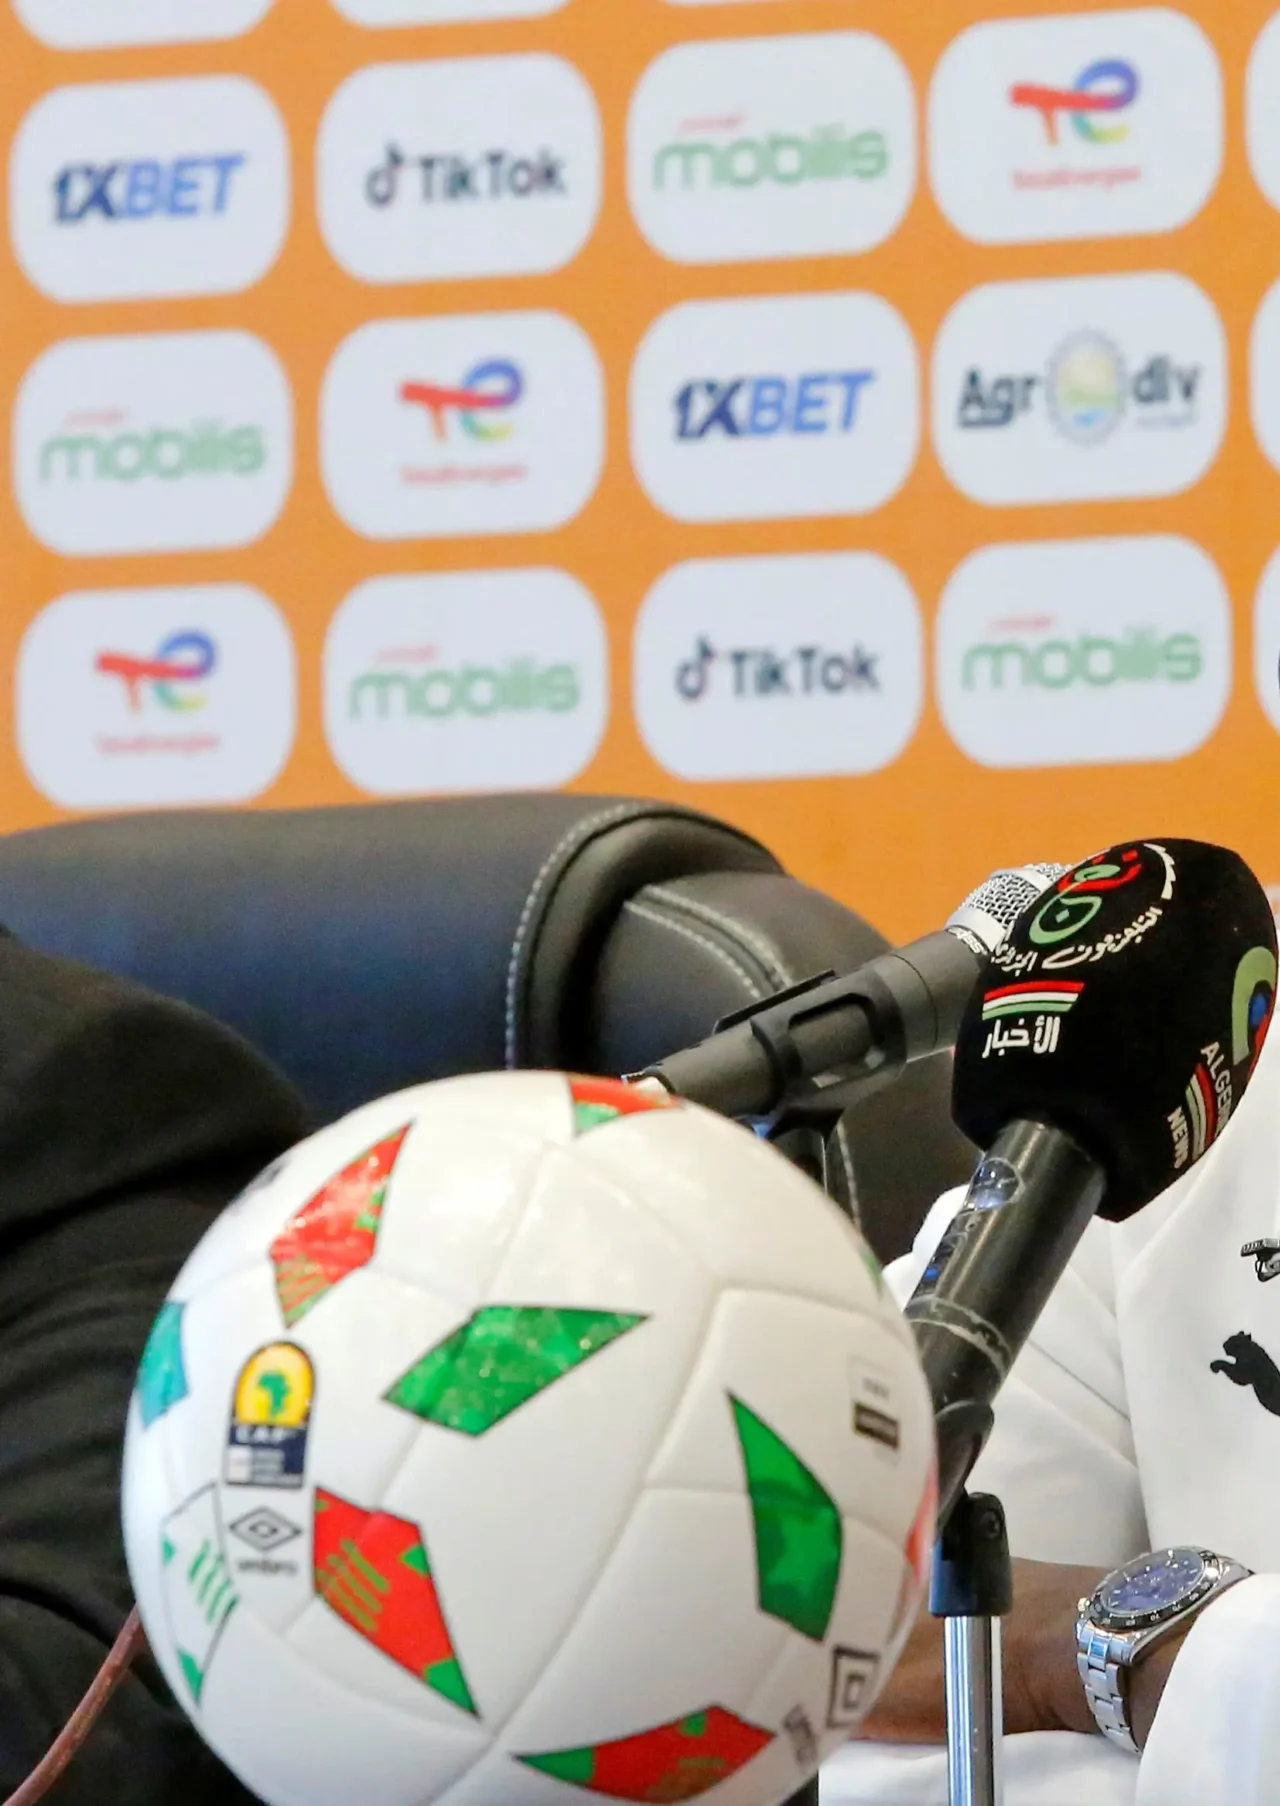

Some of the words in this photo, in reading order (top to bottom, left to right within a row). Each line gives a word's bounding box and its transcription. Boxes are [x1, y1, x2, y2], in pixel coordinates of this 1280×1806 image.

[417, 149, 567, 203] TikTok
[652, 122, 890, 190] mobilis
[51, 154, 245, 225] 1XBET
[672, 371, 875, 441] 1XBET
[38, 419, 268, 485] mobilis
[348, 656, 582, 722] mobilis
[728, 645, 881, 697] TikTok
[961, 624, 1206, 691] mobilis
[981, 1015, 1061, 1059] الأخبار
